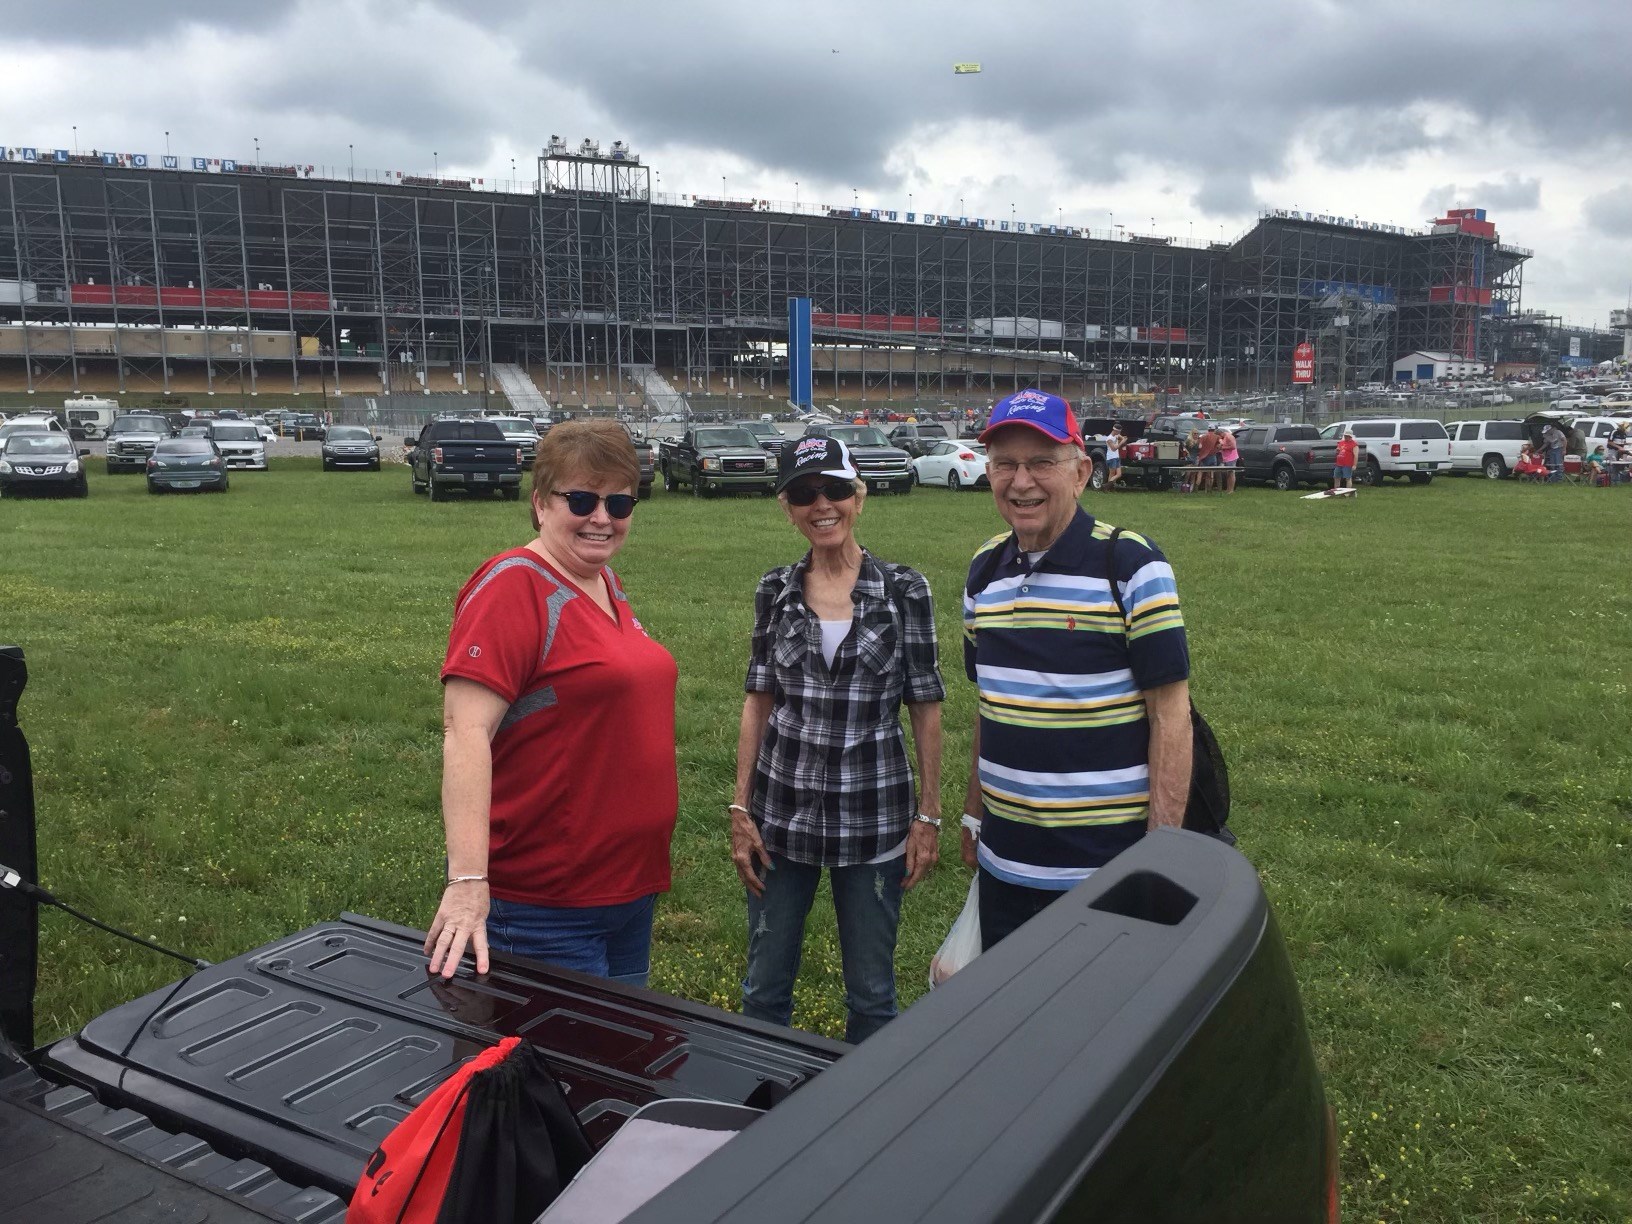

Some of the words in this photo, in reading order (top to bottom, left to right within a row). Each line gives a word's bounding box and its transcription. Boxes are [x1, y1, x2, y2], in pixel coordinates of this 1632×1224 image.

[105, 152, 237, 171] TOWER
[1002, 221, 1073, 236] TOWER
[1295, 360, 1312, 368] WALK
[1295, 370, 1311, 378] THRU
[1007, 403, 1046, 416] Racing
[795, 451, 828, 468] Racing
